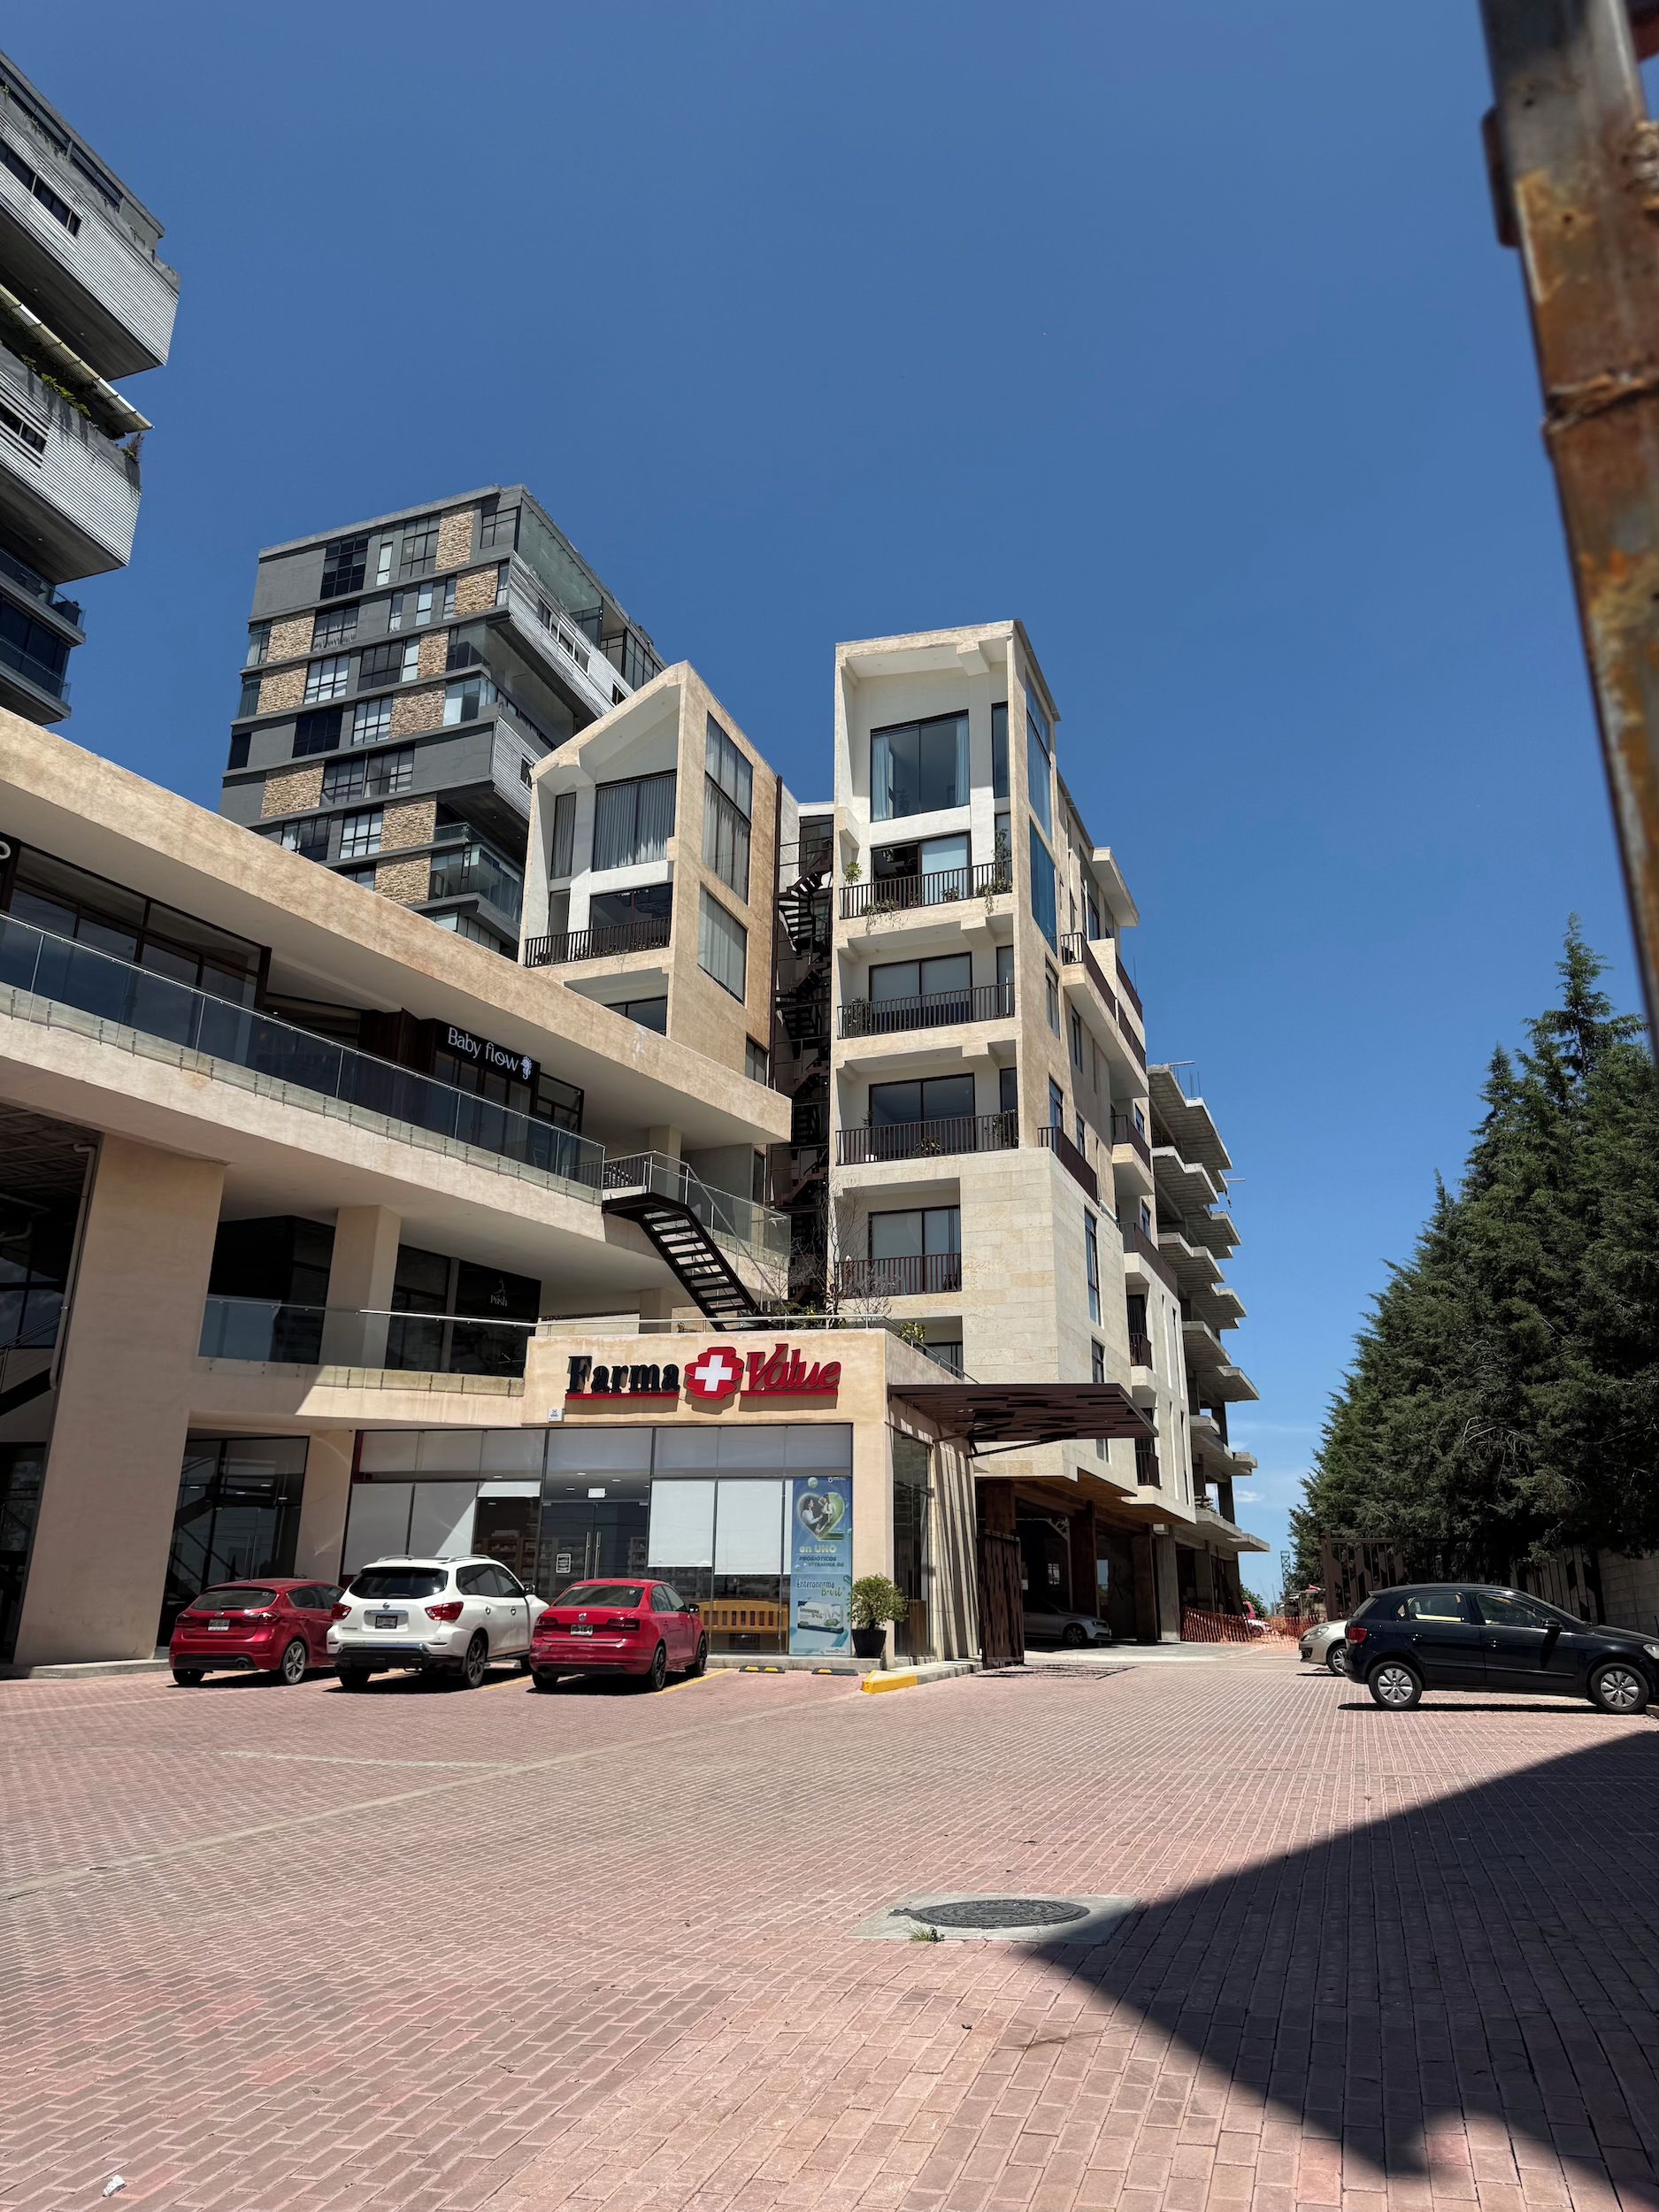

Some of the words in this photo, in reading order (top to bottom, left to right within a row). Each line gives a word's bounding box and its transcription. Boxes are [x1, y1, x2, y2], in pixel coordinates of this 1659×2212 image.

[448, 1026, 481, 1059] Baby
[566, 1356, 680, 1394] Farma
[746, 1343, 841, 1390] Value
[815, 1544, 837, 1554] UNO
